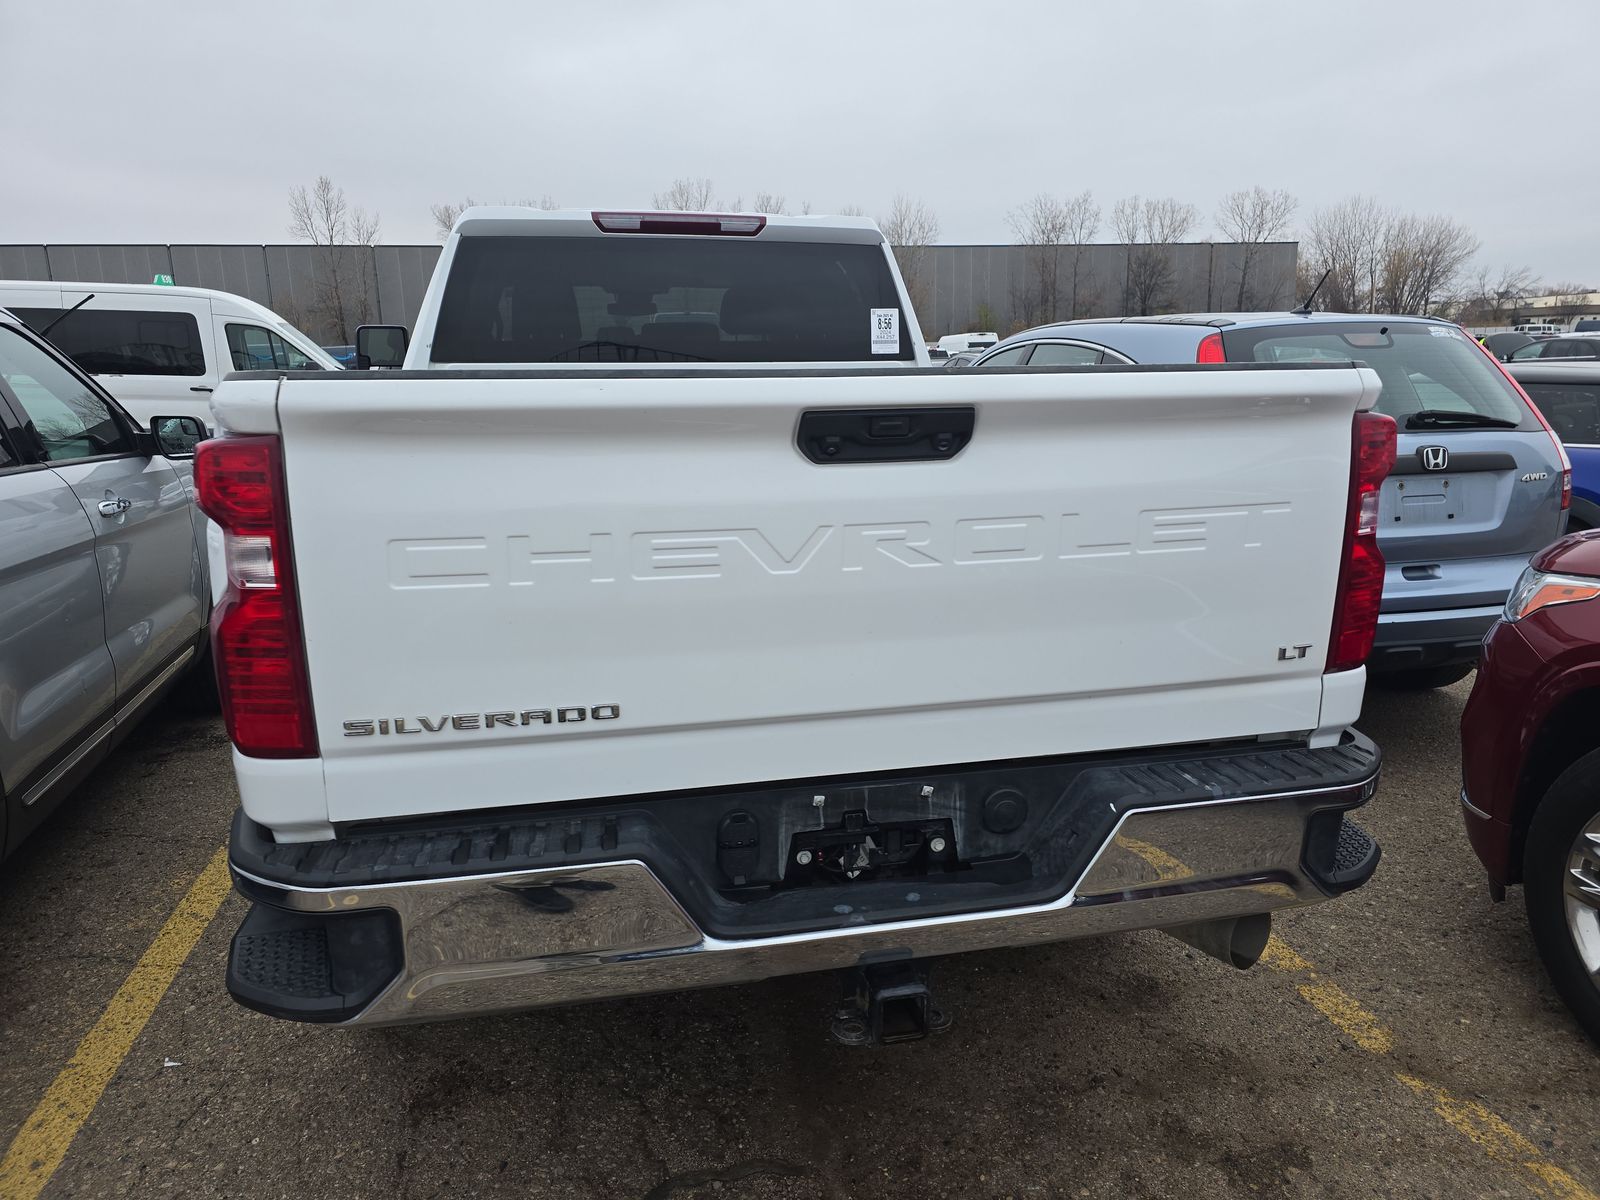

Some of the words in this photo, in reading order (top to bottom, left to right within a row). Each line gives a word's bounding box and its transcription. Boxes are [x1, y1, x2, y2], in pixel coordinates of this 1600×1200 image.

[878, 318, 892, 329] 8:56
[1521, 472, 1548, 482] 4WD
[386, 501, 1292, 590] CHEVROLET
[1278, 644, 1313, 661] LT
[343, 702, 620, 737] SILVERADO
